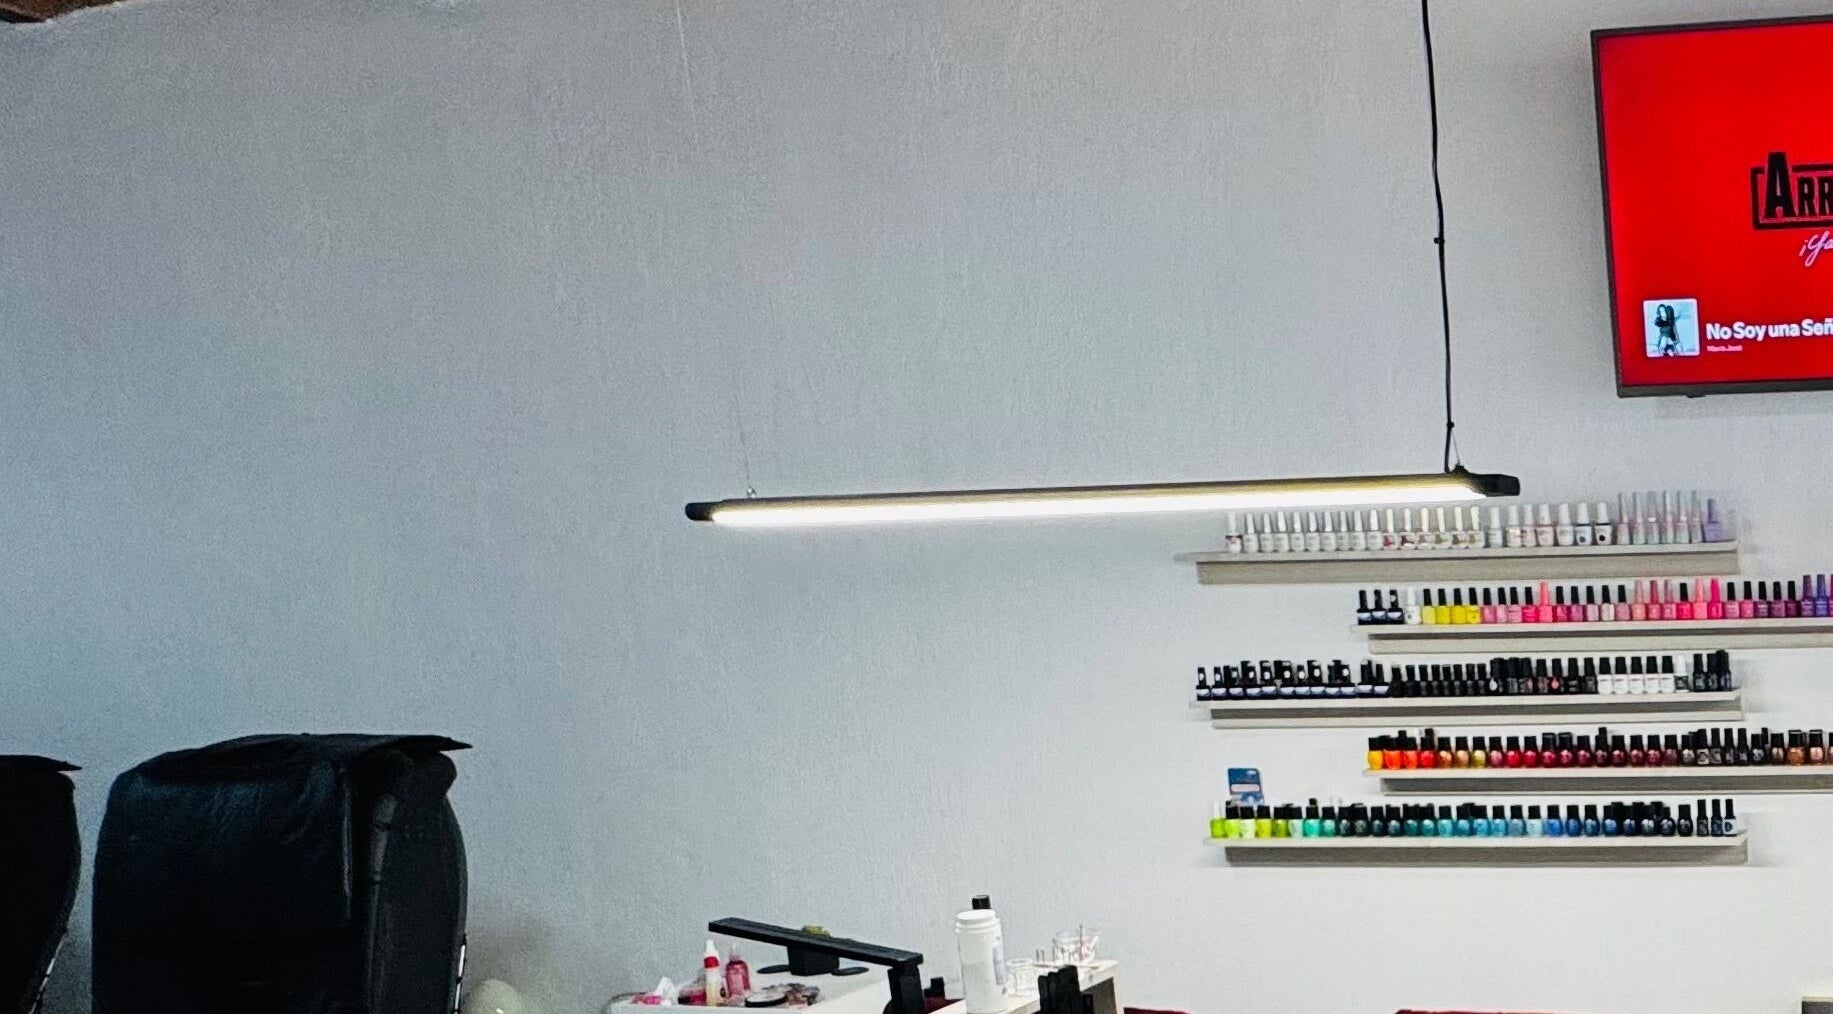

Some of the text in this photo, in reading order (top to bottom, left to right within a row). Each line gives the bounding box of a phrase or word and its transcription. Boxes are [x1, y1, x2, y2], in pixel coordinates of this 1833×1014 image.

[1705, 323, 1733, 340] No
[1733, 321, 1766, 341] Soy
[1768, 324, 1800, 338] una
